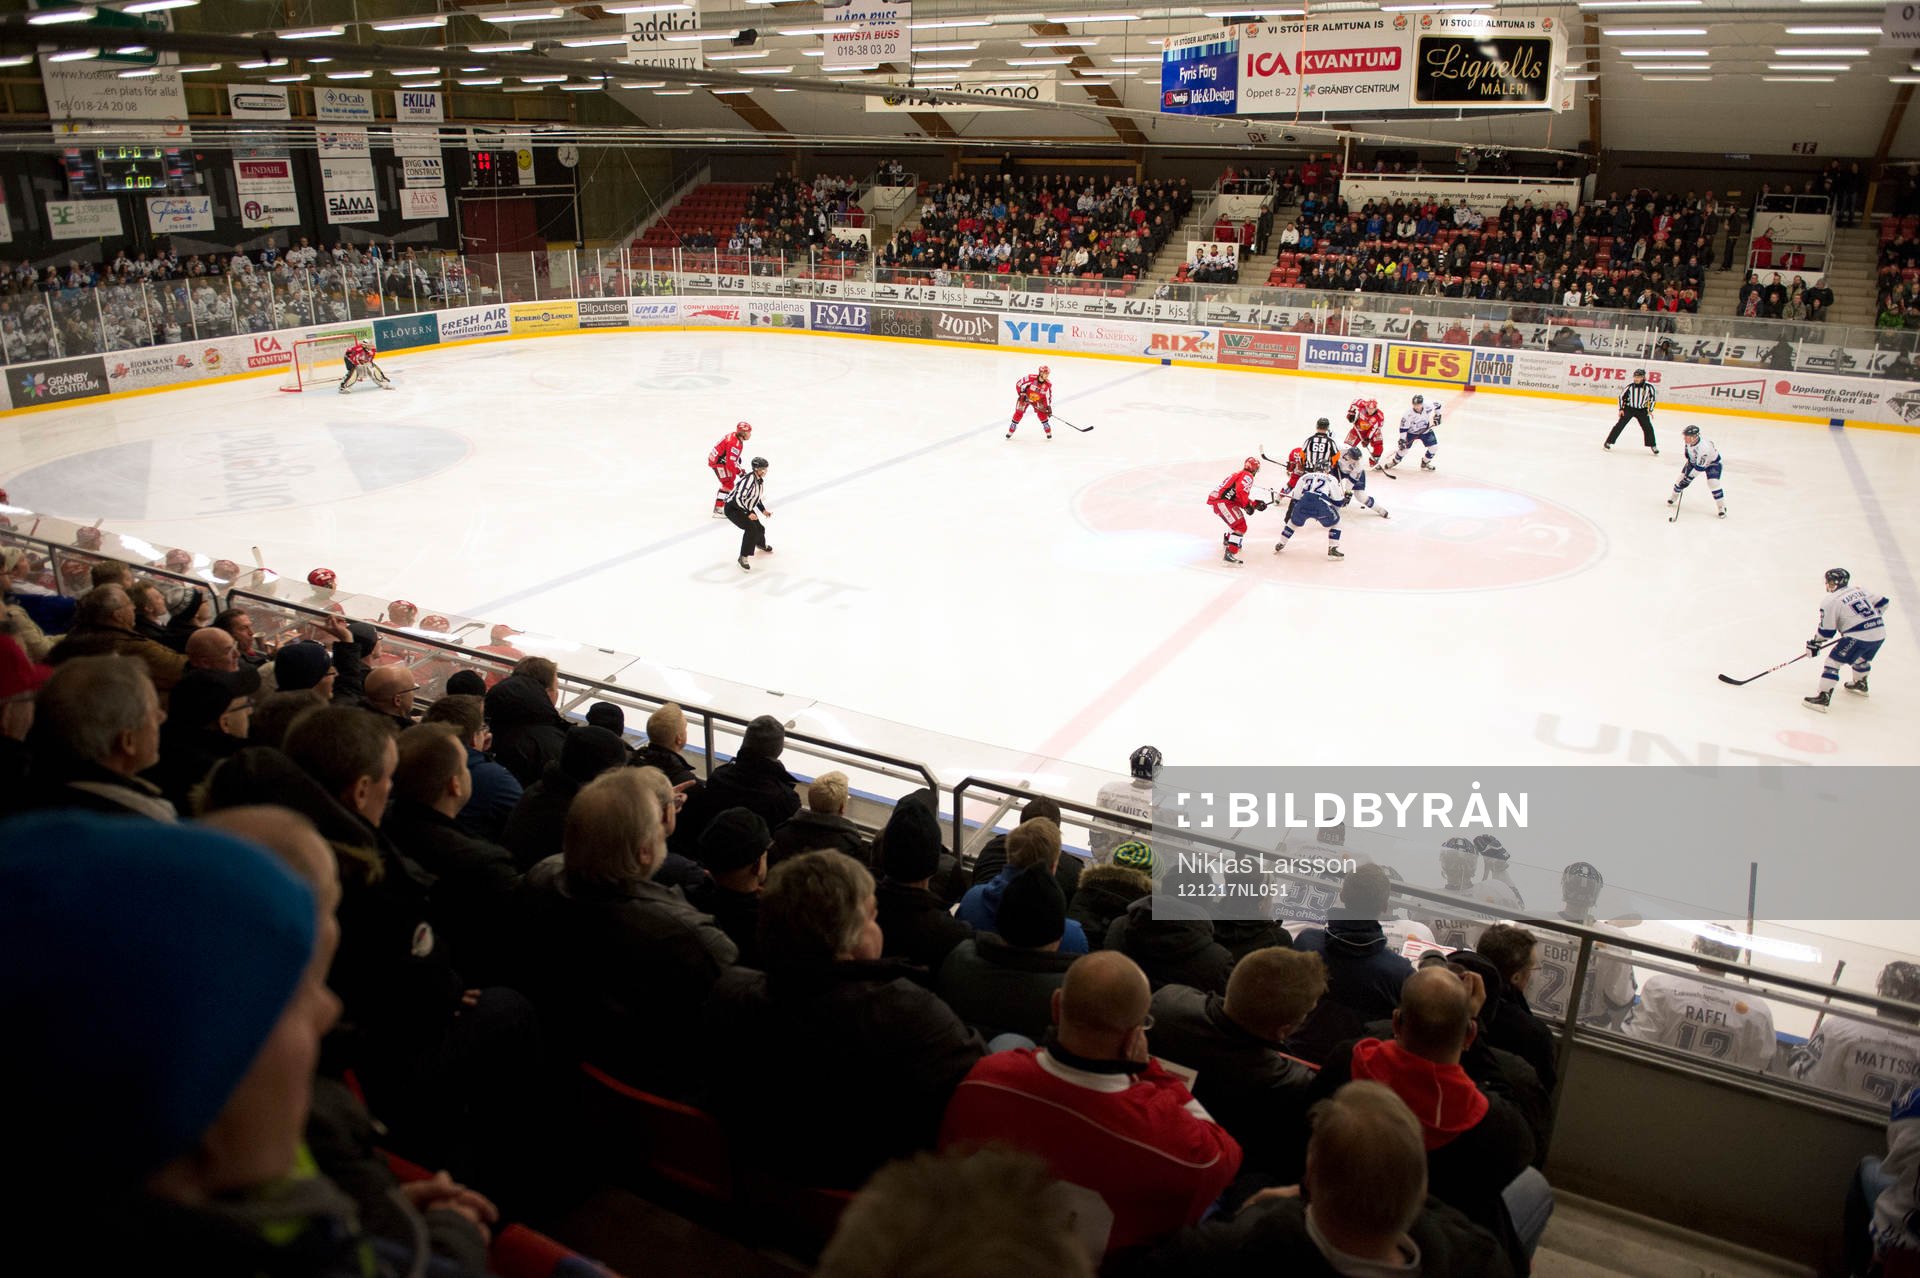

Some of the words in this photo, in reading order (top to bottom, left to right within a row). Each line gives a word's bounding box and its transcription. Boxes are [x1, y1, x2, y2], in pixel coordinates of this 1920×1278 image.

[1267, 26, 1278, 34] VI
[1323, 22, 1371, 32] ALMTUNA
[1374, 20, 1384, 29] IS
[1486, 19, 1525, 28] ALMTUNA
[833, 32, 871, 41] KNIVSTA
[874, 30, 900, 39] BUSS
[838, 46, 868, 56] 018-38
[870, 45, 882, 54] 03
[884, 44, 896, 54] 20
[634, 57, 697, 70] SECURITY
[1247, 52, 1292, 77] ICA
[1303, 51, 1396, 70] KVANTUM
[1427, 44, 1543, 90] Lignells
[1179, 66, 1197, 84] Fyris
[1199, 64, 1217, 81] Färg
[120, 86, 142, 97] plats
[144, 86, 157, 97] för
[1246, 87, 1273, 99] Öppet
[1318, 84, 1353, 94] GRÄNBY
[1354, 83, 1400, 93] CENTRUM
[1481, 79, 1528, 95] MÅLERI
[338, 92, 364, 104] Ocab
[403, 93, 436, 107] EKILLA
[112, 101, 123, 111] 20
[125, 101, 137, 111] 08
[246, 166, 282, 175] LINDAHL
[406, 168, 441, 176] CONSTRUCT
[329, 194, 374, 211] SÅMA
[580, 302, 627, 314] Bilputsen
[749, 300, 805, 313] magdalenas
[442, 315, 479, 331] FRESH
[484, 308, 506, 323] AIR
[726, 311, 740, 320] EL
[814, 304, 867, 327] FSAB
[442, 323, 492, 336] Ventilation
[495, 319, 508, 329] AB
[938, 312, 993, 336] HODJA
[383, 325, 432, 339] KLÖVERN
[1005, 320, 1063, 344] YIT
[254, 337, 282, 353] ICA
[1152, 333, 1201, 353] RIX
[1200, 342, 1215, 350] FM
[250, 354, 291, 367] KVANTUM
[1309, 345, 1364, 363] hemma
[1397, 350, 1461, 377] UFS
[1474, 360, 1512, 376] KONTOR
[48, 372, 88, 386] GRÄNBY
[1569, 363, 1627, 381] LÖJTE
[50, 380, 100, 396] CENTRUM
[1711, 386, 1760, 400] IHUS
[1792, 385, 1836, 395] Upplands
[1839, 389, 1880, 399] Grafiska
[1823, 394, 1858, 404] Etikett
[1313, 443, 1325, 452] 68
[1275, 906, 1295, 917] clas
[1685, 1005, 1727, 1028] RAFFL
